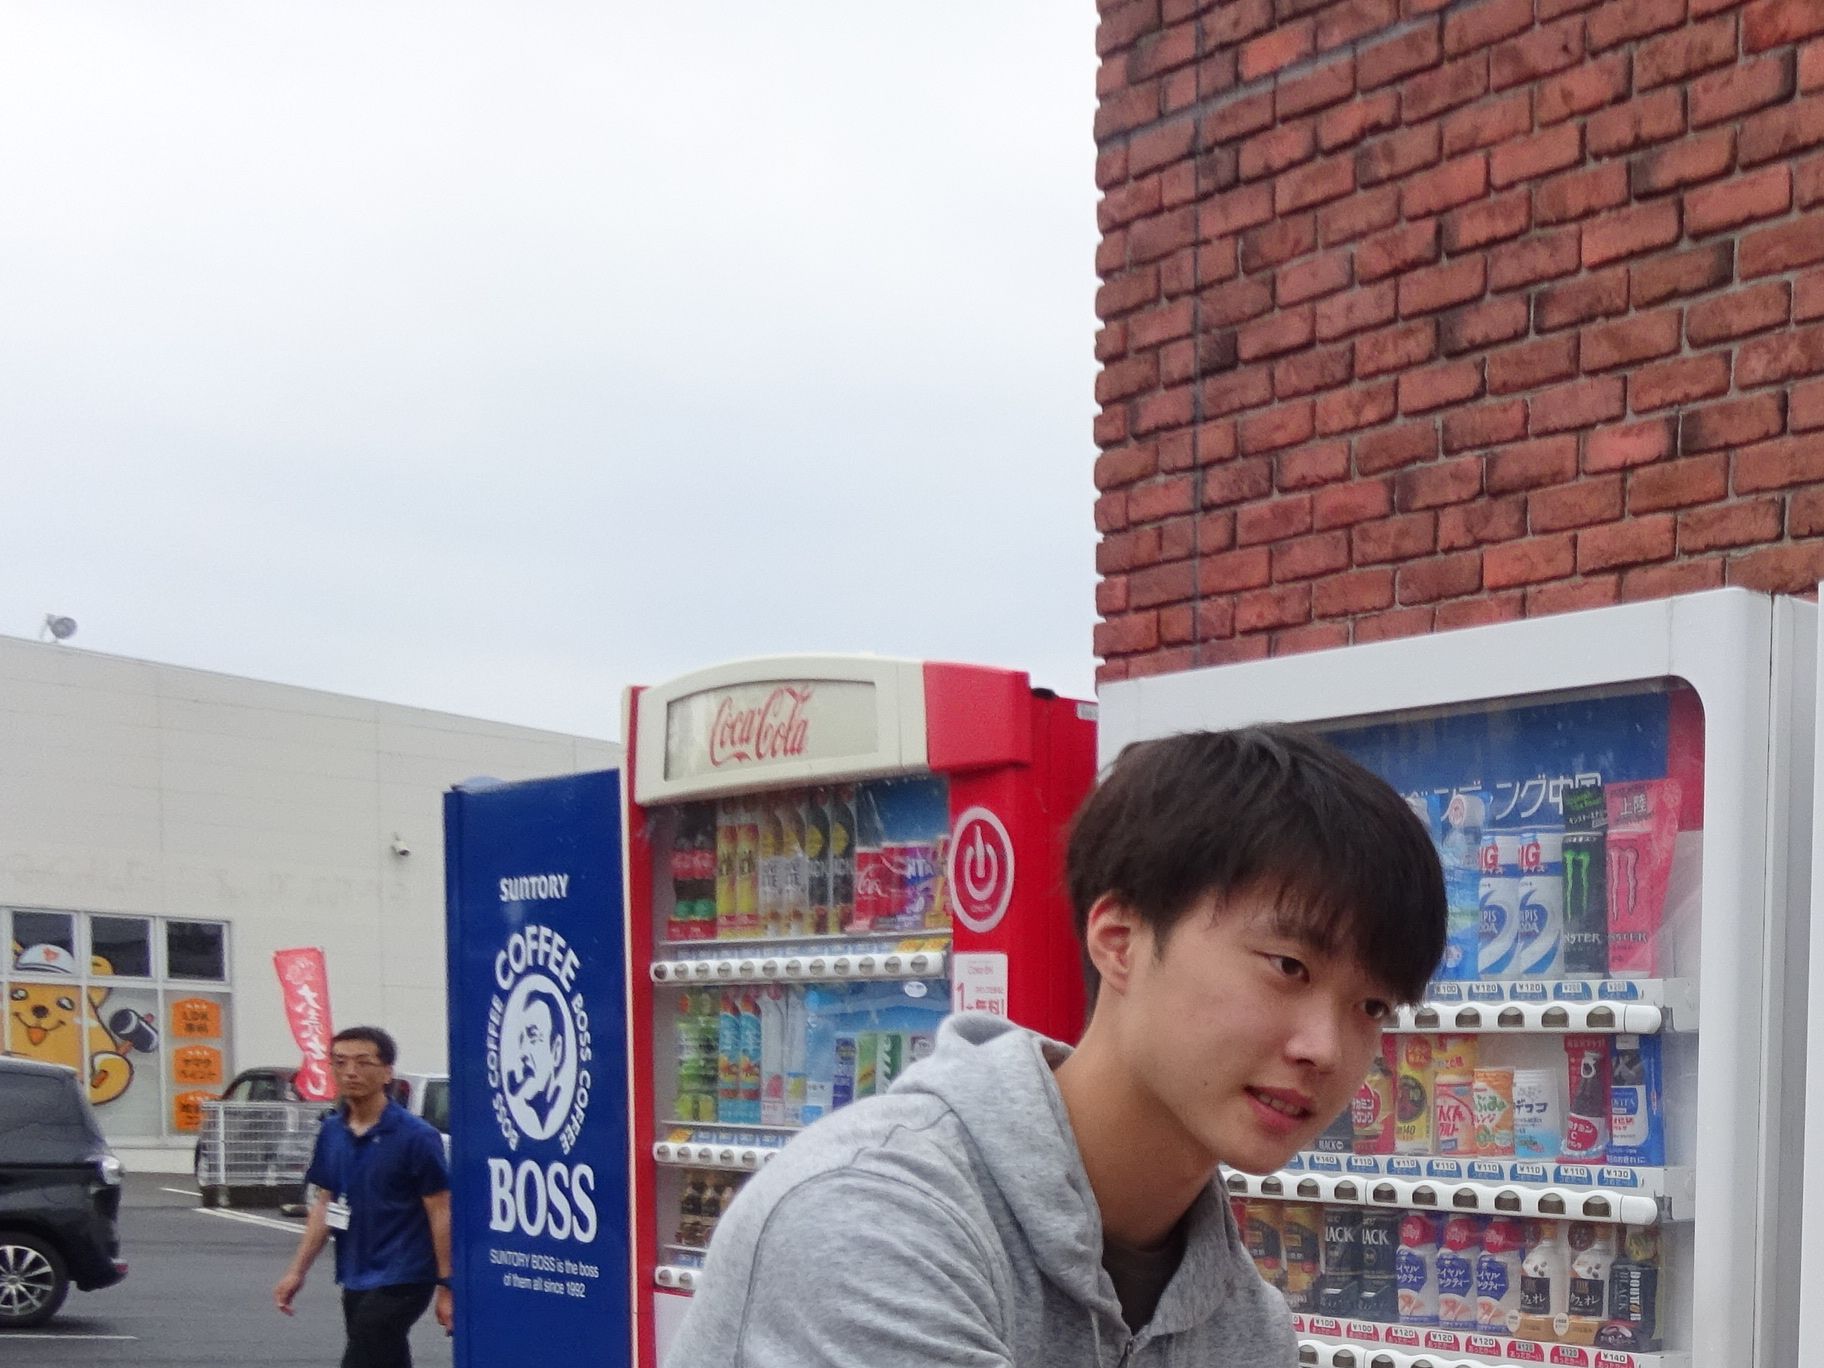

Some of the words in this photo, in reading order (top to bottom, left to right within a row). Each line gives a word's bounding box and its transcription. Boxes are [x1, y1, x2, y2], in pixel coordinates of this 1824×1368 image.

[710, 687, 815, 768] Coca-Cola
[495, 924, 582, 992] COFFEE
[486, 994, 505, 1088] COFFEE
[571, 993, 592, 1062] BOSS
[558, 1070, 592, 1155] COFFEE
[488, 1158, 597, 1243] BOSS
[490, 1248, 530, 1268] SUNTORY
[531, 1254, 556, 1272] BOSS
[556, 1259, 564, 1273] is
[565, 1260, 578, 1275] the
[579, 1261, 599, 1278] boss
[503, 1273, 512, 1286] of
[513, 1273, 532, 1289] them
[533, 1277, 543, 1291] all
[544, 1279, 565, 1294] since
[566, 1281, 586, 1298] 1992
